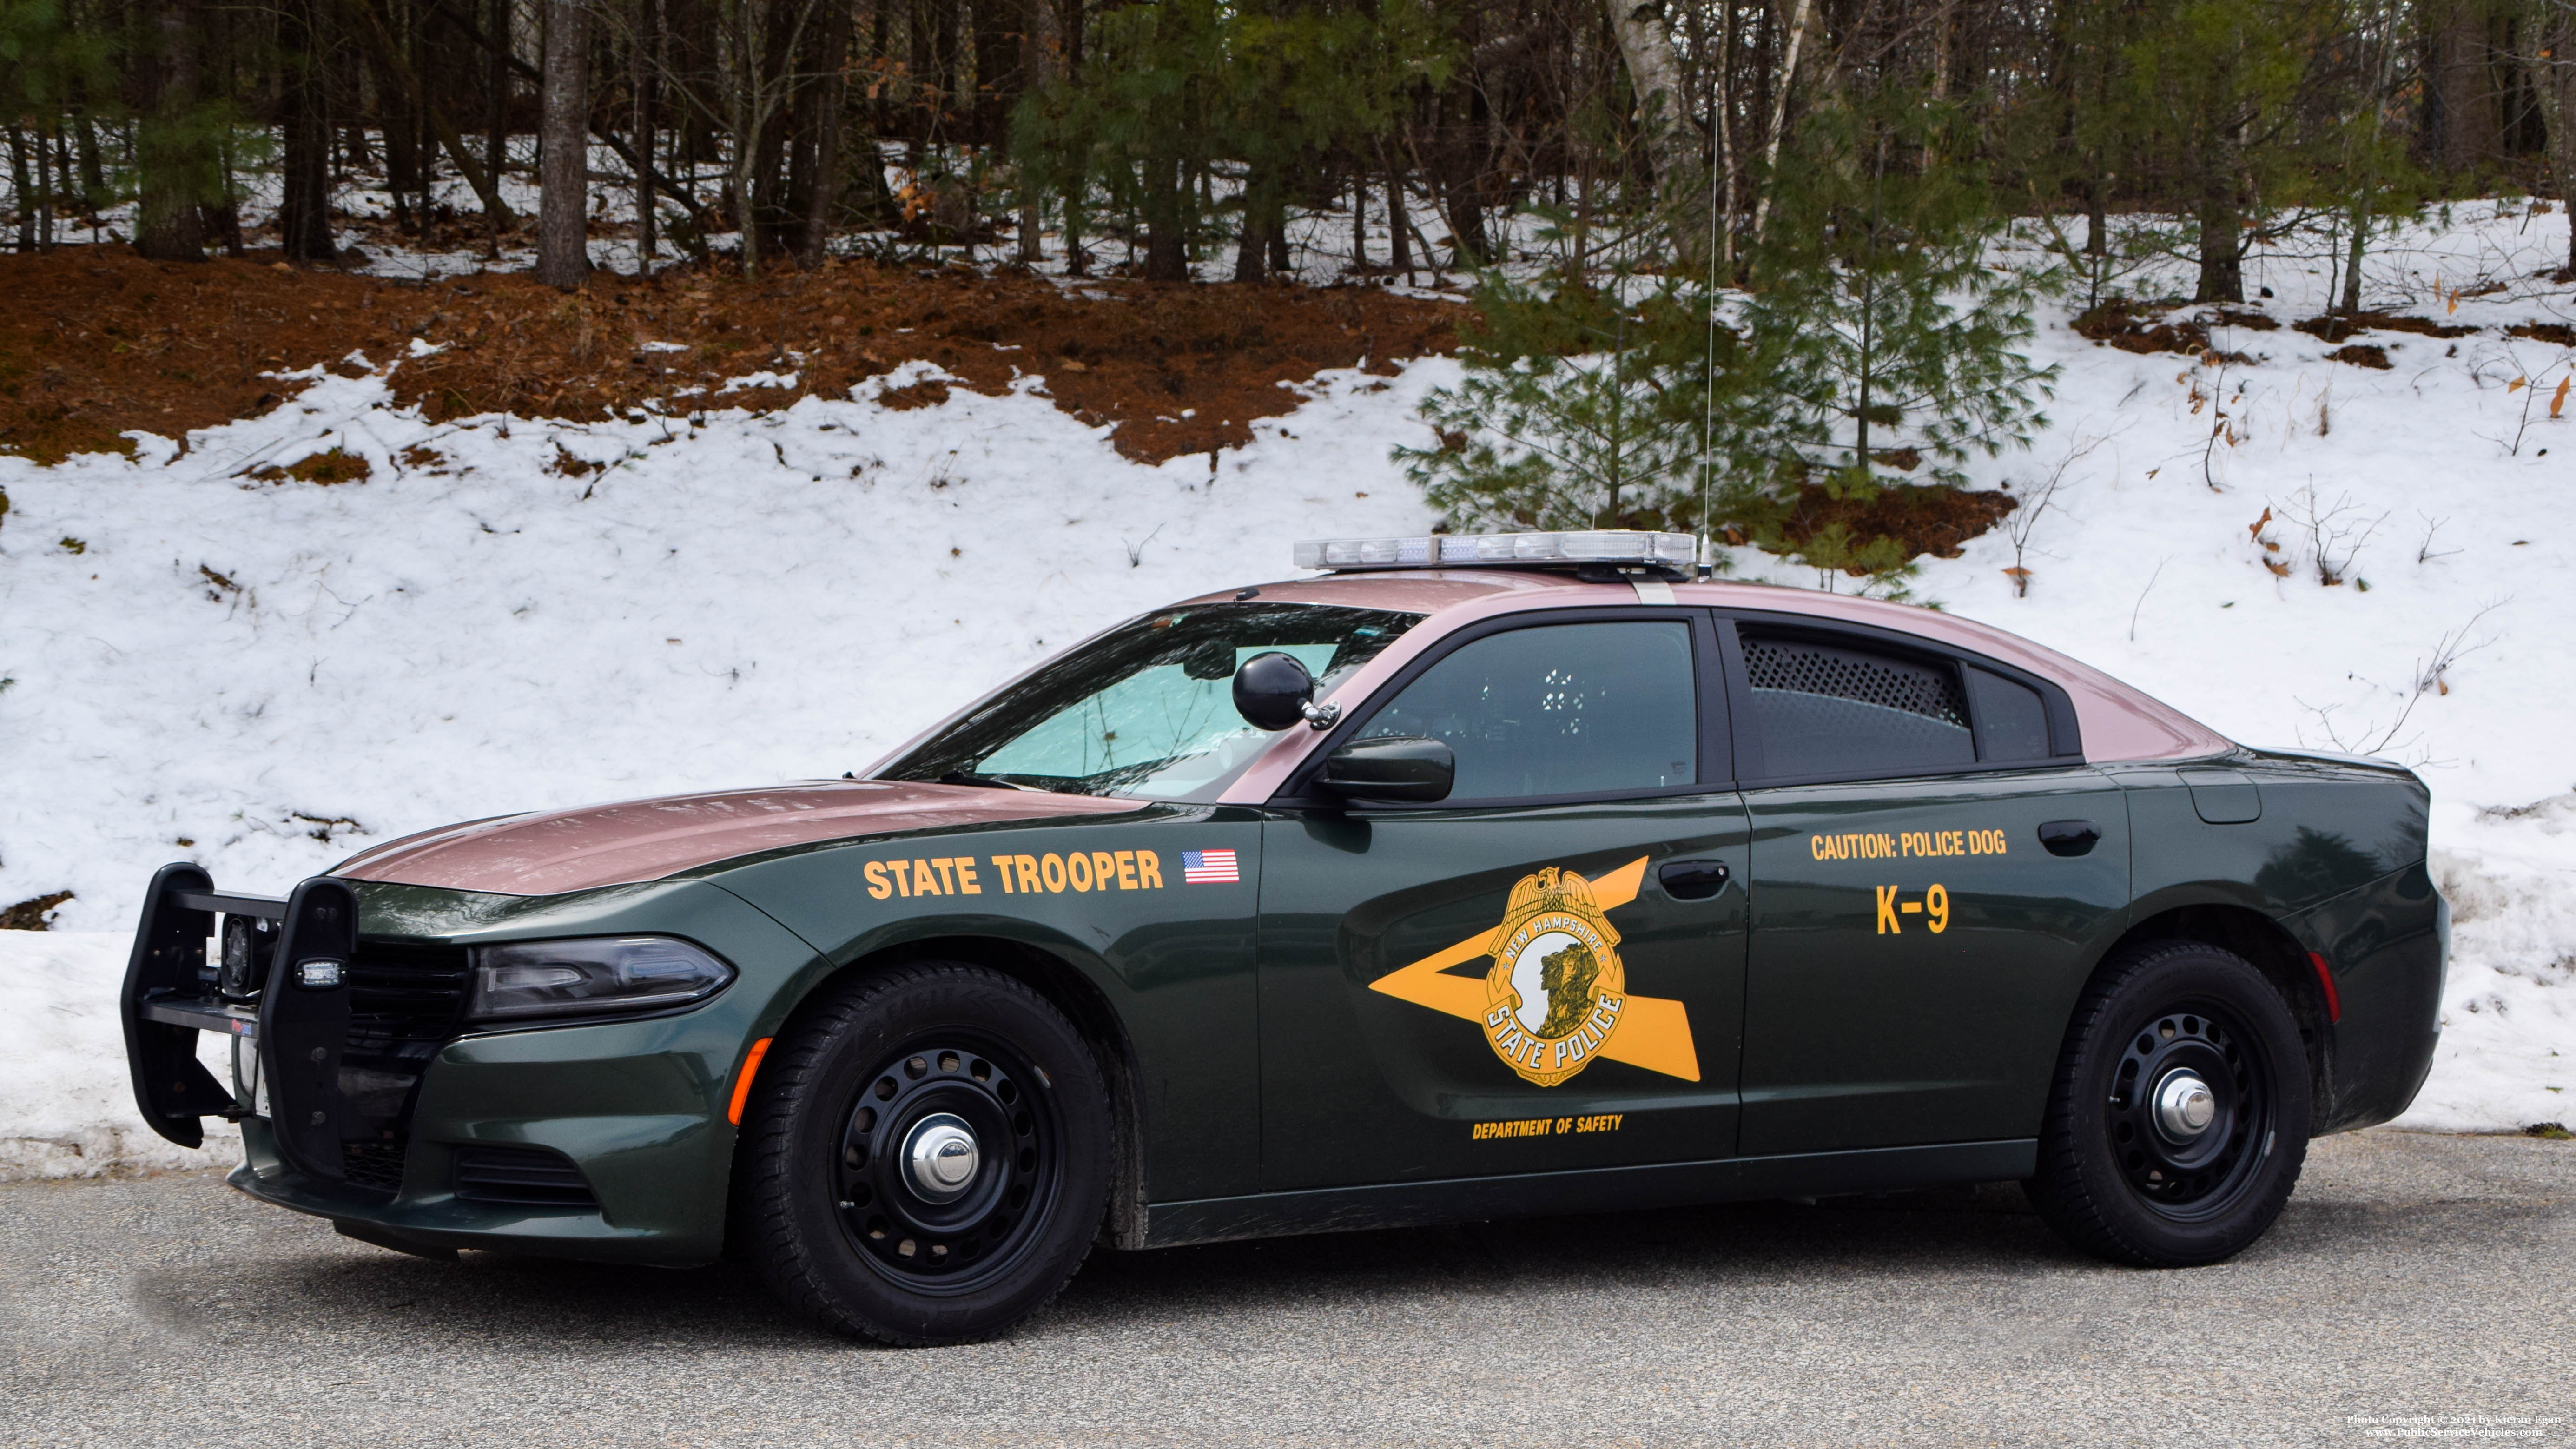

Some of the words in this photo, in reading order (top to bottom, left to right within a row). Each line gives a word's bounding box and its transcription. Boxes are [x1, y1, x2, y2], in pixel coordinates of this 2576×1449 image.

[1811, 833, 1897, 860] CAUTION:
[1900, 830, 1966, 857] POLICE
[1968, 829, 2007, 854] DOG
[864, 856, 982, 900] STATE
[991, 849, 1163, 894] TROOPER
[1876, 883, 1949, 934] K-9
[1505, 929, 1529, 959] NEW
[1533, 917, 1603, 953] HAMPSHIRE
[1487, 1005, 1546, 1068] STATE
[1555, 994, 1622, 1068] POLICE
[1472, 1118, 1552, 1140] DEPARTMENT
[1556, 1117, 1573, 1134] OF
[1576, 1114, 1623, 1133] SAFETY
